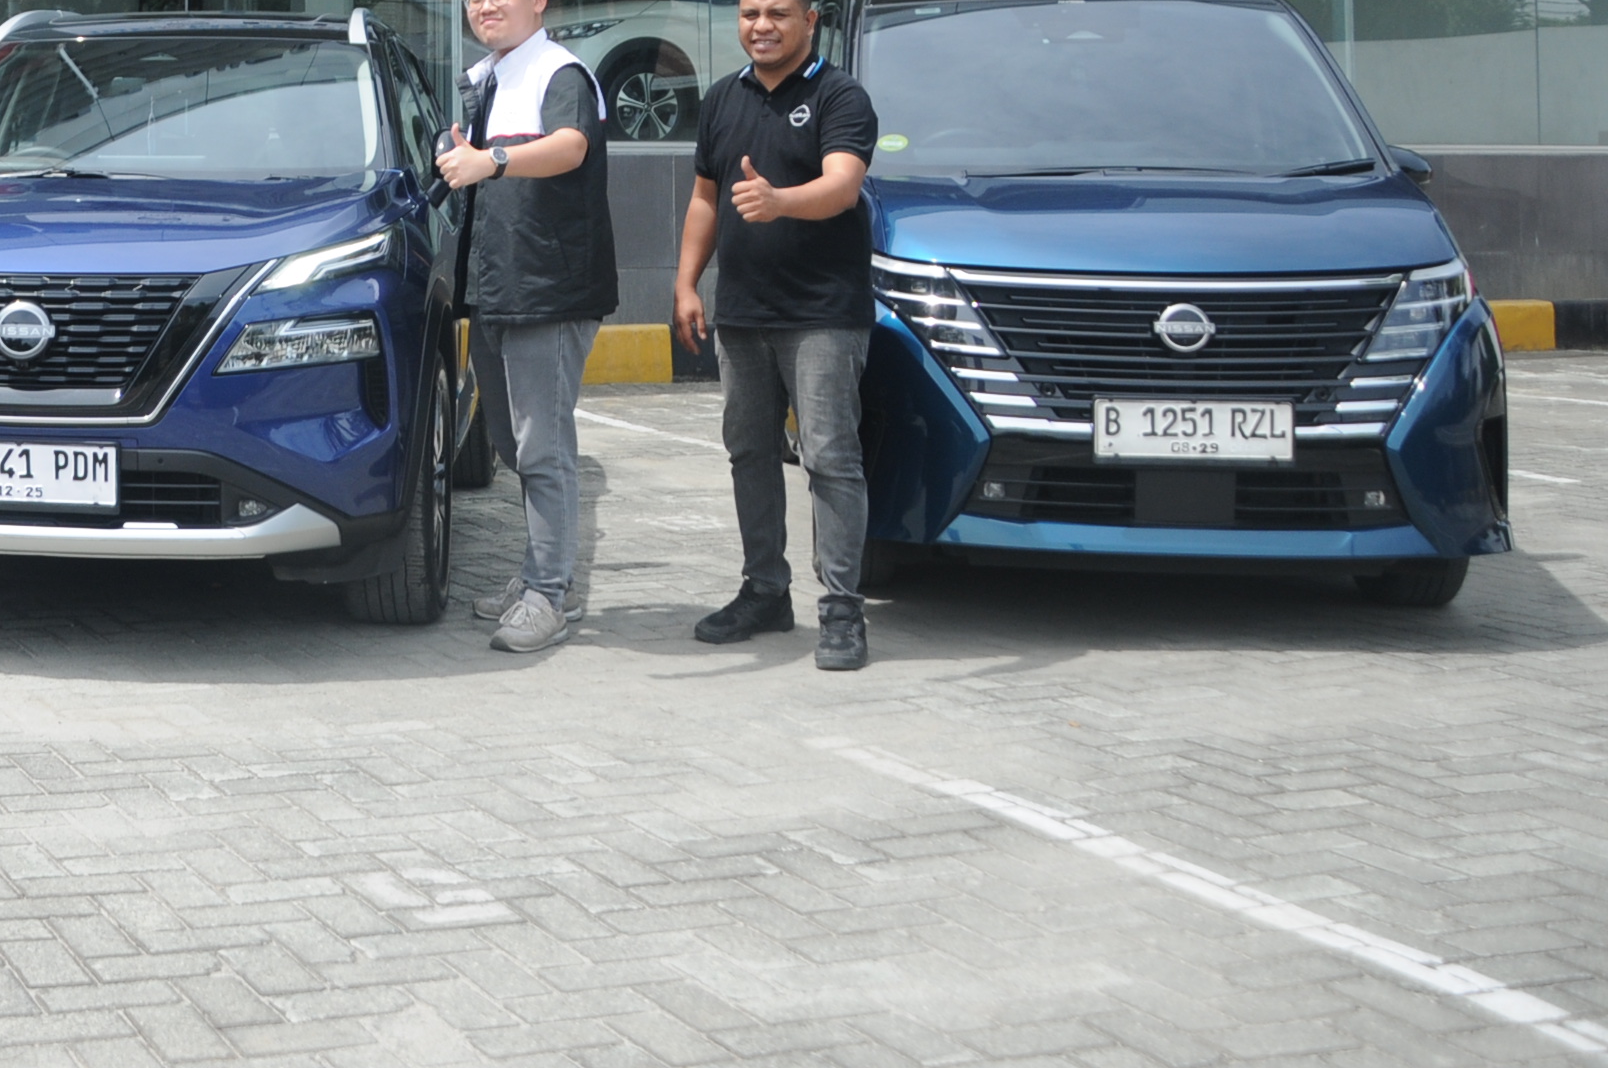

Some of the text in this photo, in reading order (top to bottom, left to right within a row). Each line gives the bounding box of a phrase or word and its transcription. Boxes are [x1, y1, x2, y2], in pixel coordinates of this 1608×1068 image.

[1156, 323, 1215, 333] NISSAN
[1105, 406, 1286, 440] B 1251 RZL
[53, 449, 109, 483] PDM
